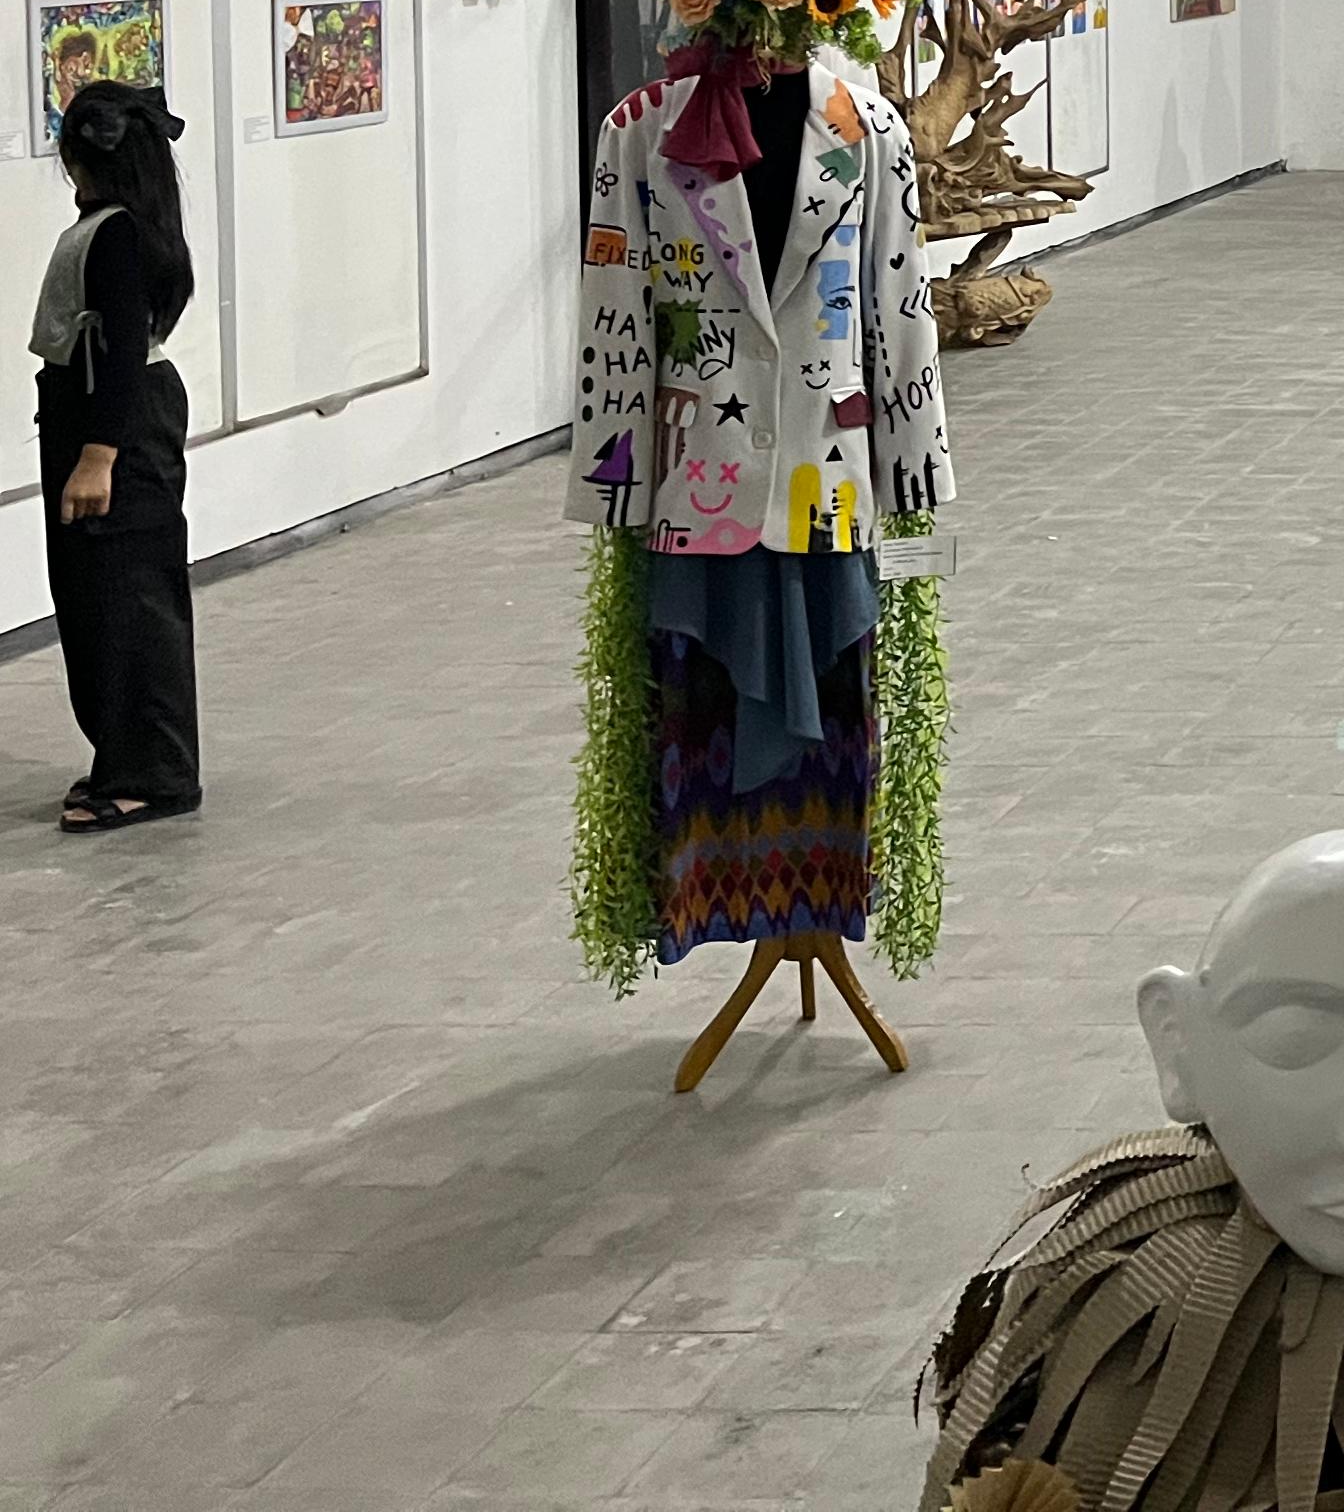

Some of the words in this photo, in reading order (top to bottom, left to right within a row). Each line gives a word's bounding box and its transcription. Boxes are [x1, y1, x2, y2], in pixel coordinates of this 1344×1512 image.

[648, 243, 704, 265] LONG
[664, 271, 713, 293] WAY
[605, 346, 651, 377] HA
[603, 390, 646, 415] HA
